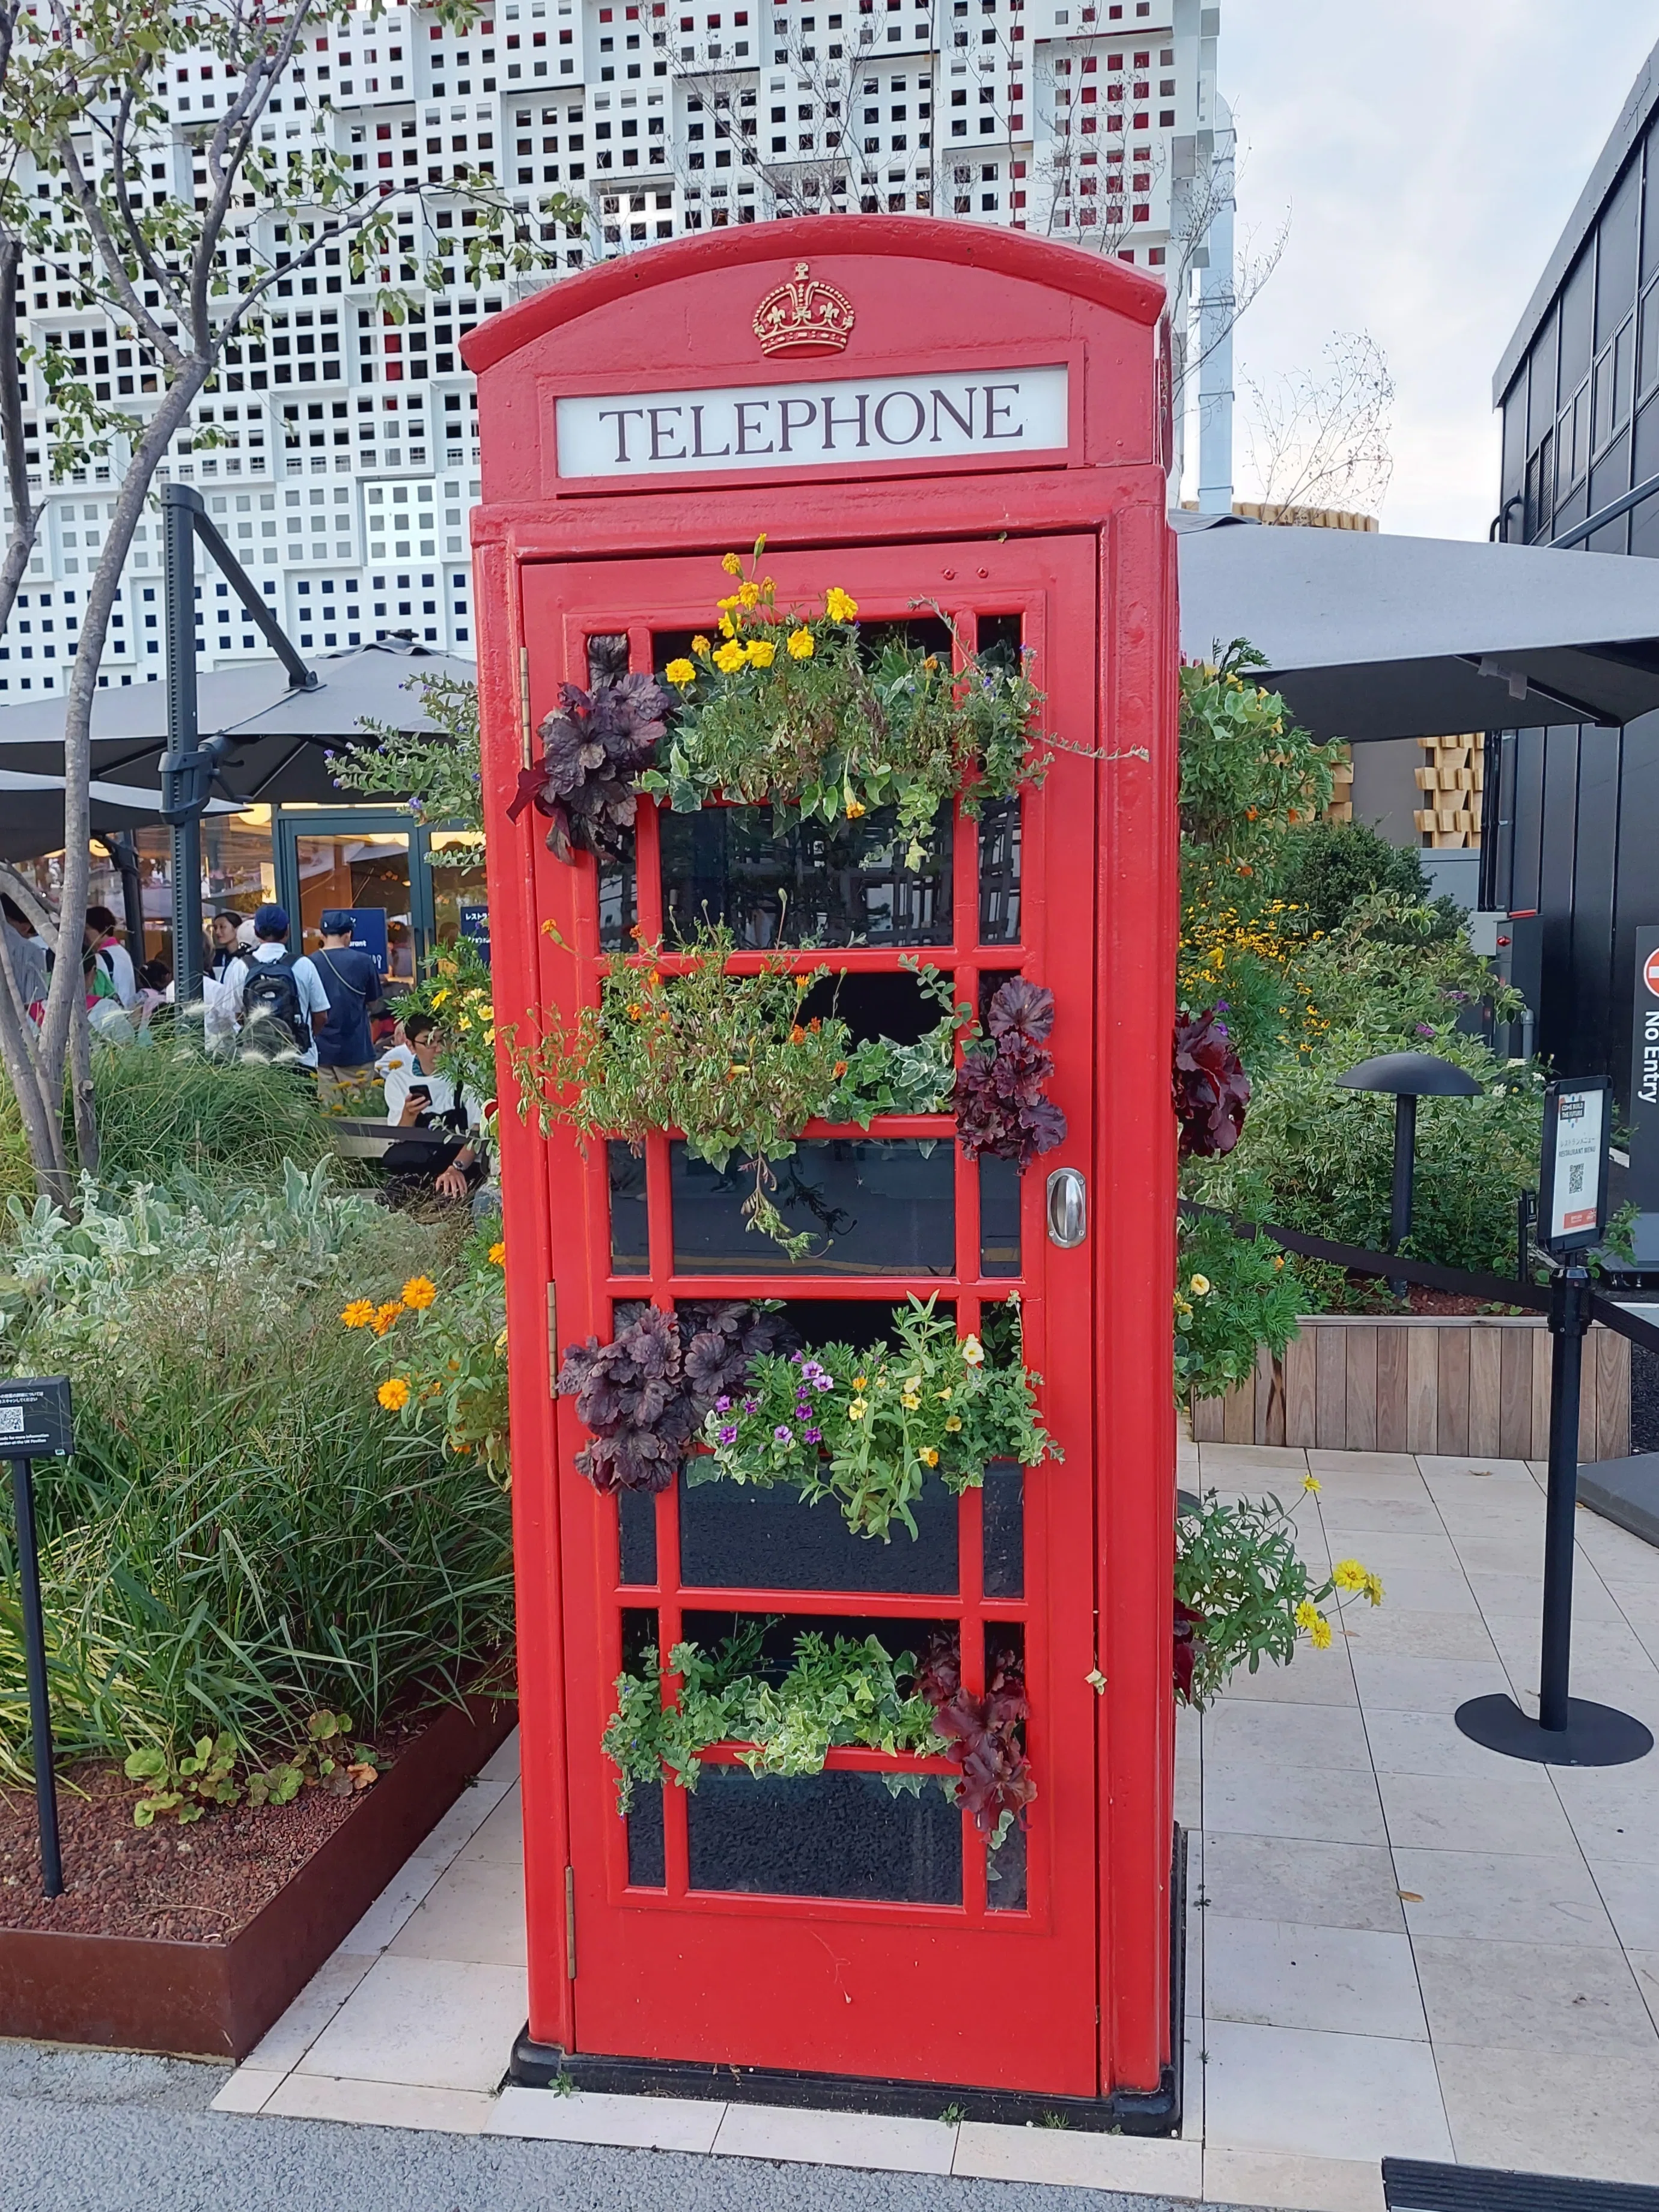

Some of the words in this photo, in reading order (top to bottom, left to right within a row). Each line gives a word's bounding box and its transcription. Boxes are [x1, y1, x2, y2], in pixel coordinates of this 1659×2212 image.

[599, 383, 1024, 463] TELEPHONE
[1645, 1011, 1659, 1041] No
[1637, 1046, 1659, 1104] Entry
[1559, 1148, 1584, 1157] RESTAURANT
[1560, 1137, 1595, 1147] レストランメニュー
